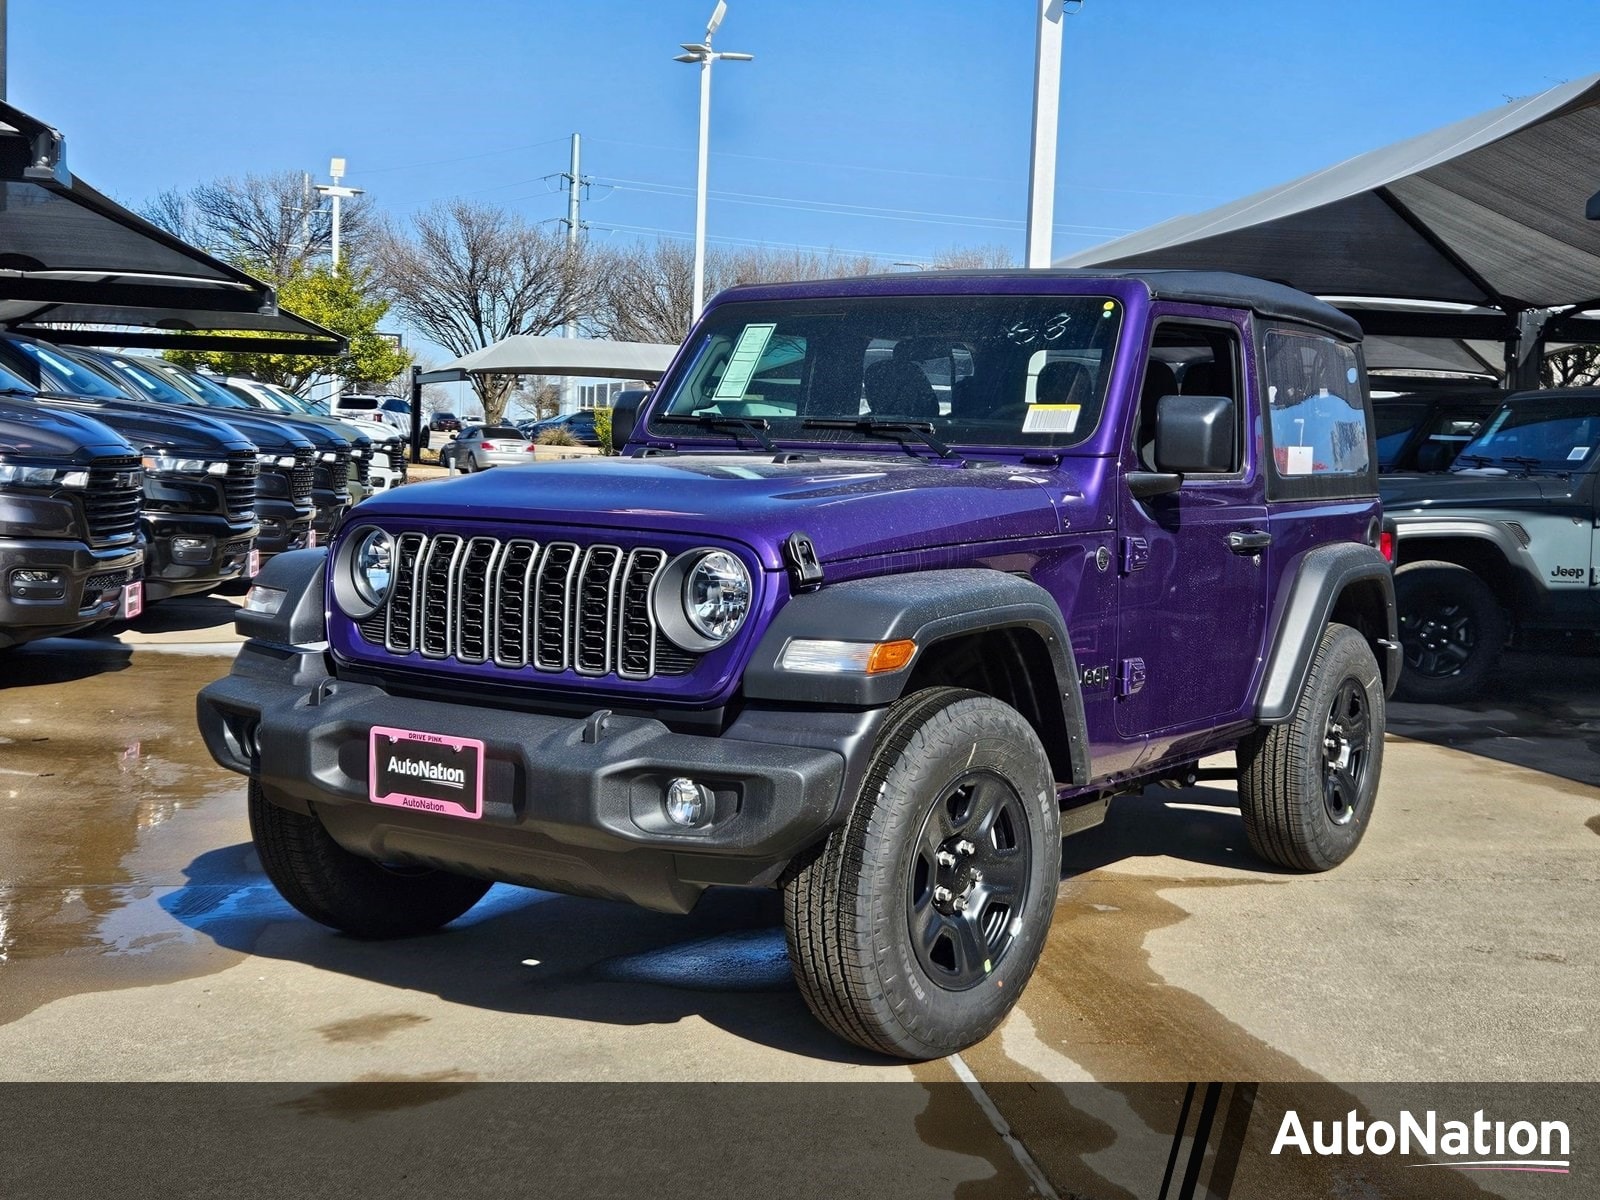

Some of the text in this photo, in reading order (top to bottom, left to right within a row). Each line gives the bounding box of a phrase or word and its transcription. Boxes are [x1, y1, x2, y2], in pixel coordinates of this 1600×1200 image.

[1550, 565, 1585, 579] Jeep
[408, 732, 426, 741] DRIVE
[387, 756, 465, 783] AutoNation
[402, 797, 446, 812] AutoNation
